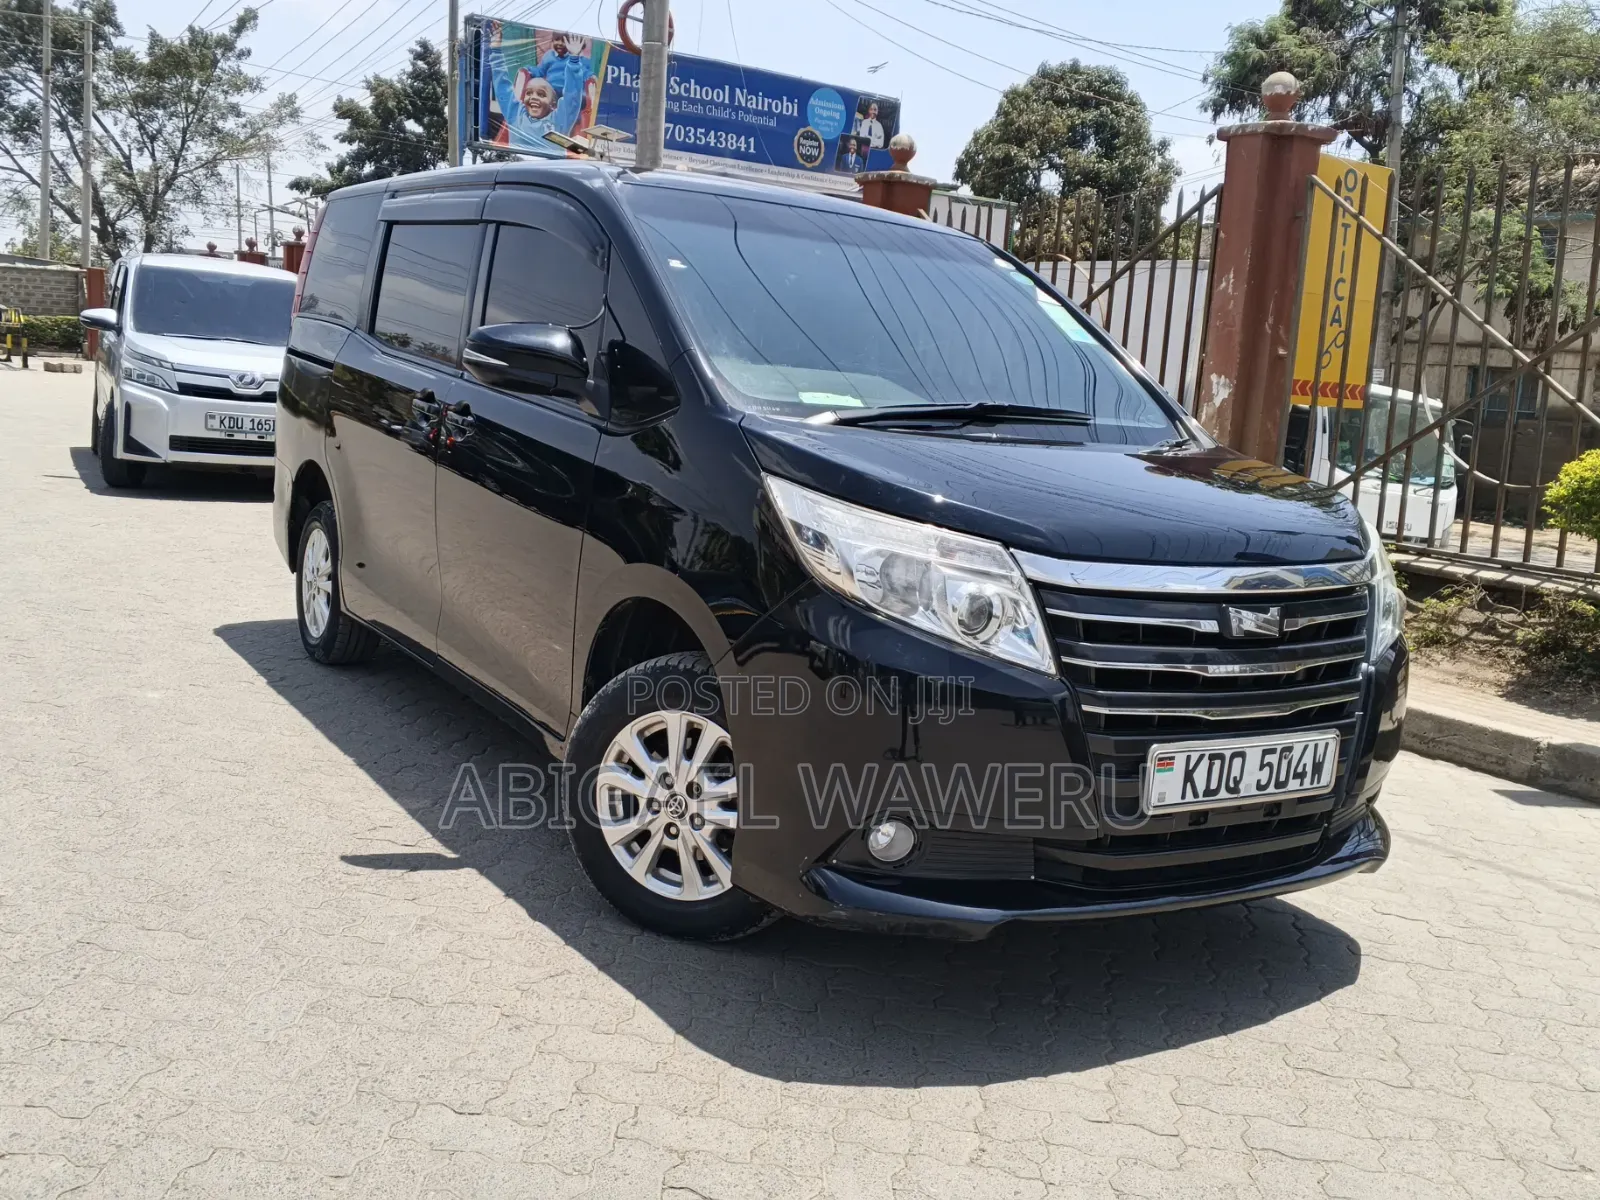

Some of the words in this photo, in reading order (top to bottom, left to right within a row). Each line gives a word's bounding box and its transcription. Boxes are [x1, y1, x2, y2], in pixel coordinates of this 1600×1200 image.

[669, 76, 730, 103] School
[734, 87, 799, 117] Nairobi
[809, 98, 845, 111] Admissions
[681, 100, 704, 116] Each
[706, 103, 736, 120] Child's
[738, 110, 777, 127] Potential
[814, 107, 841, 119] Ongoing
[799, 137, 819, 147] Register
[799, 146, 820, 157] NOW
[688, 156, 709, 165] Beyond
[1330, 168, 1359, 329] OPTICA
[219, 416, 244, 430] KDU
[1181, 750, 1247, 800] KDQ
[1256, 741, 1330, 792] 504W
